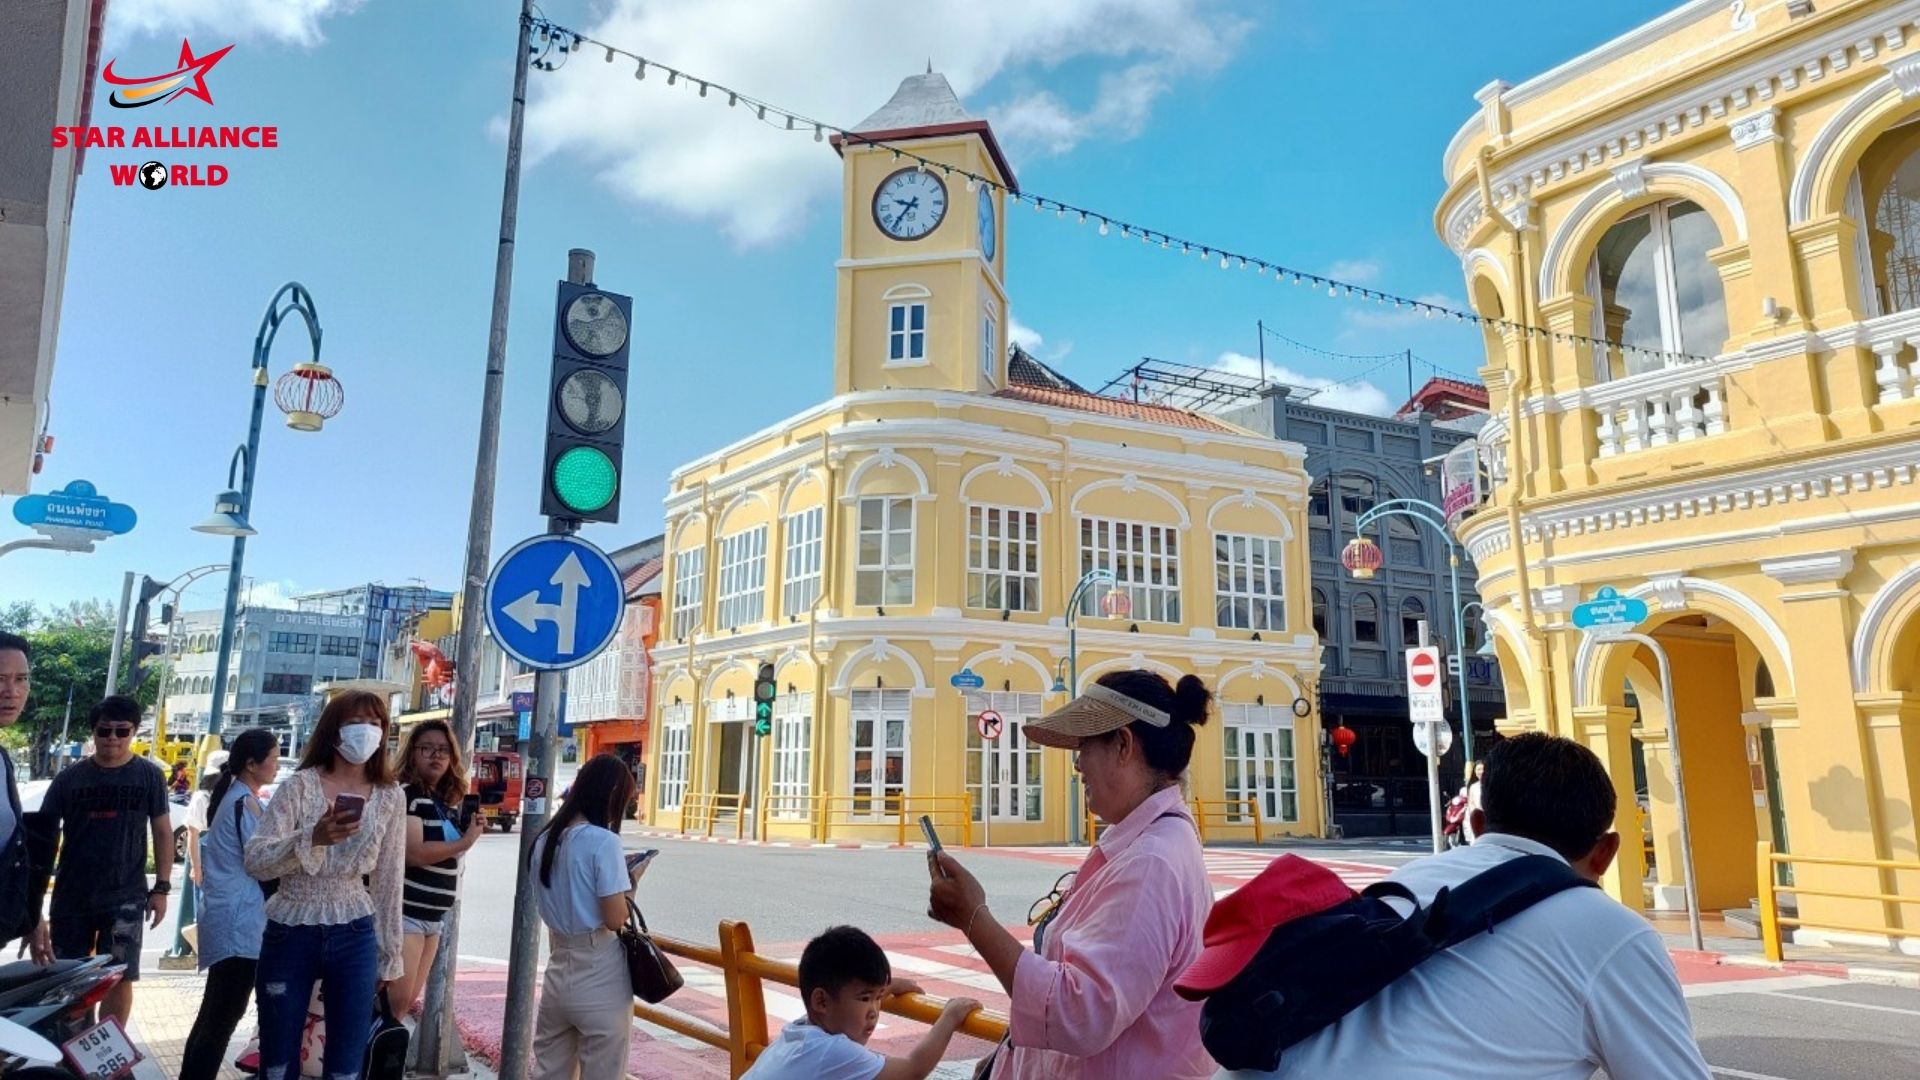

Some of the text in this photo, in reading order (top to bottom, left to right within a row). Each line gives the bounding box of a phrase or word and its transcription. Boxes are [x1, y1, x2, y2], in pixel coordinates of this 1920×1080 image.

[47, 503, 106, 517] ถนนพังงา
[97, 1053, 129, 1077] 285
